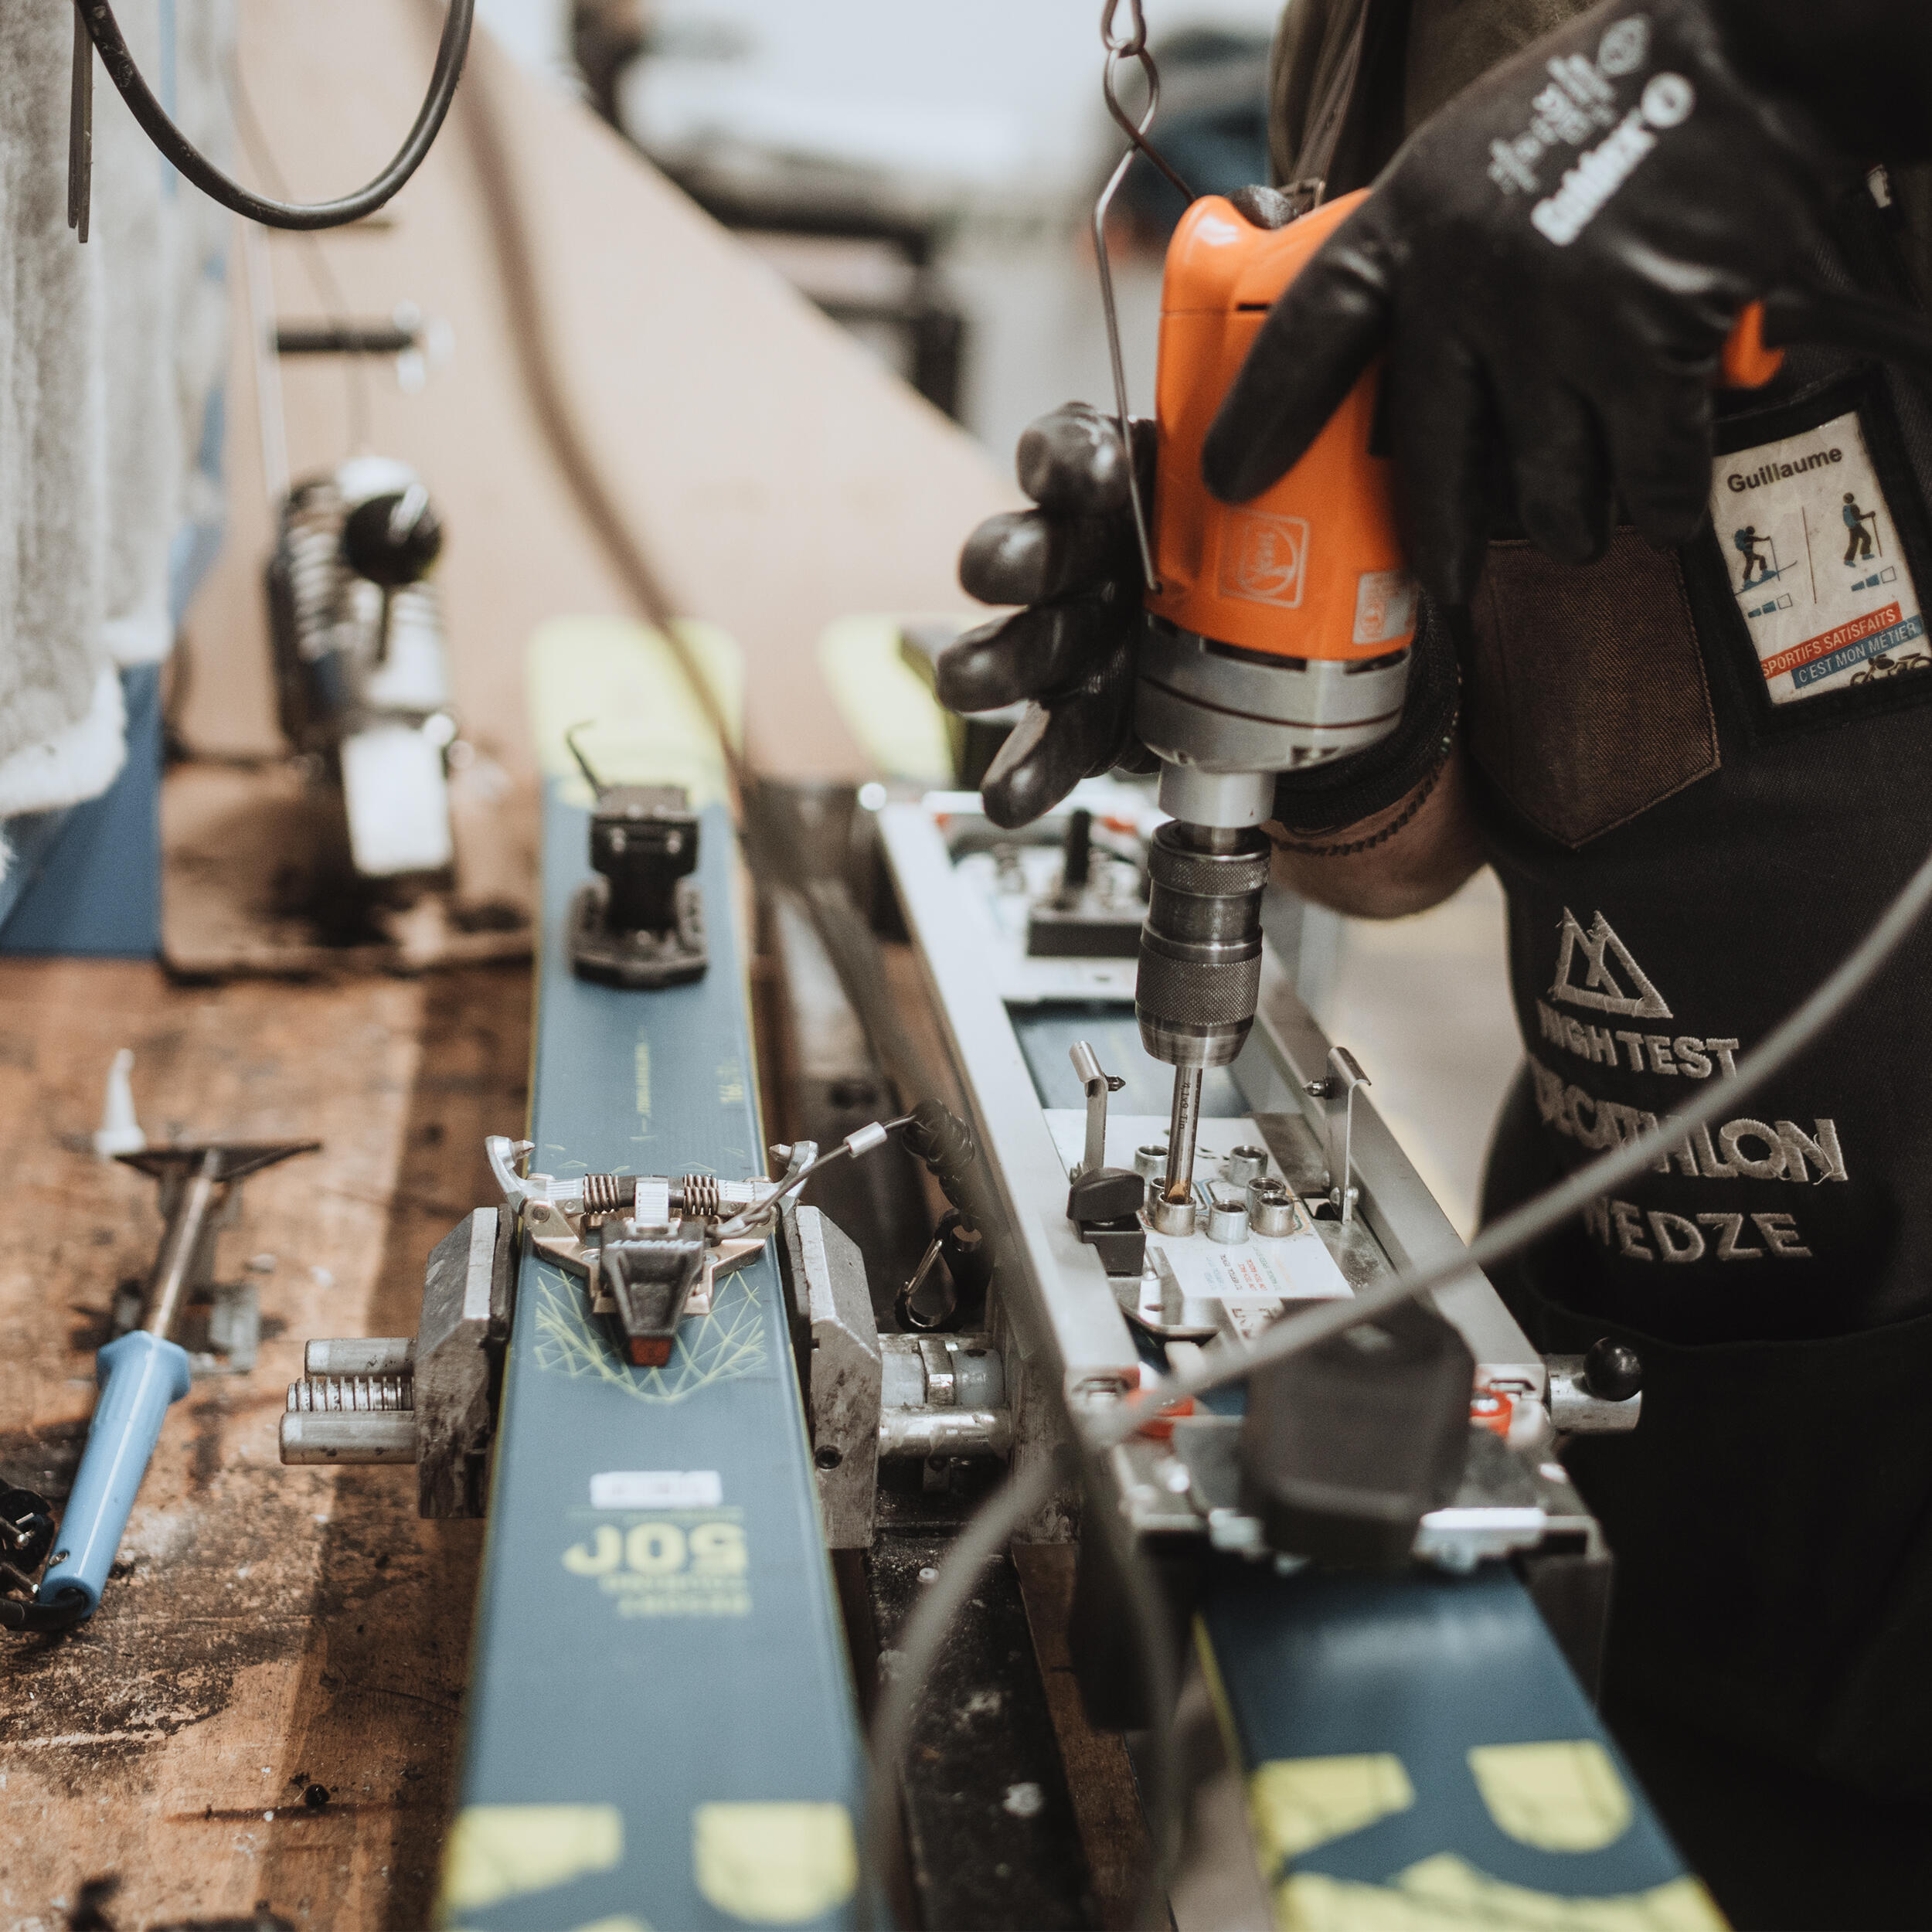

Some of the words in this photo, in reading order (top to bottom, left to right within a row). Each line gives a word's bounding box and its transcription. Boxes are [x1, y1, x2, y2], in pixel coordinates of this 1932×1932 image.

[1727, 448, 1842, 493] Guillaume
[1760, 641, 1822, 677] SPORTIFS
[1824, 608, 1896, 649] SATISFAITS
[1798, 659, 1833, 683] C'EST
[1836, 648, 1866, 667] MON
[1868, 622, 1917, 654] MÉTIER
[1616, 1030, 1740, 1080] TEST
